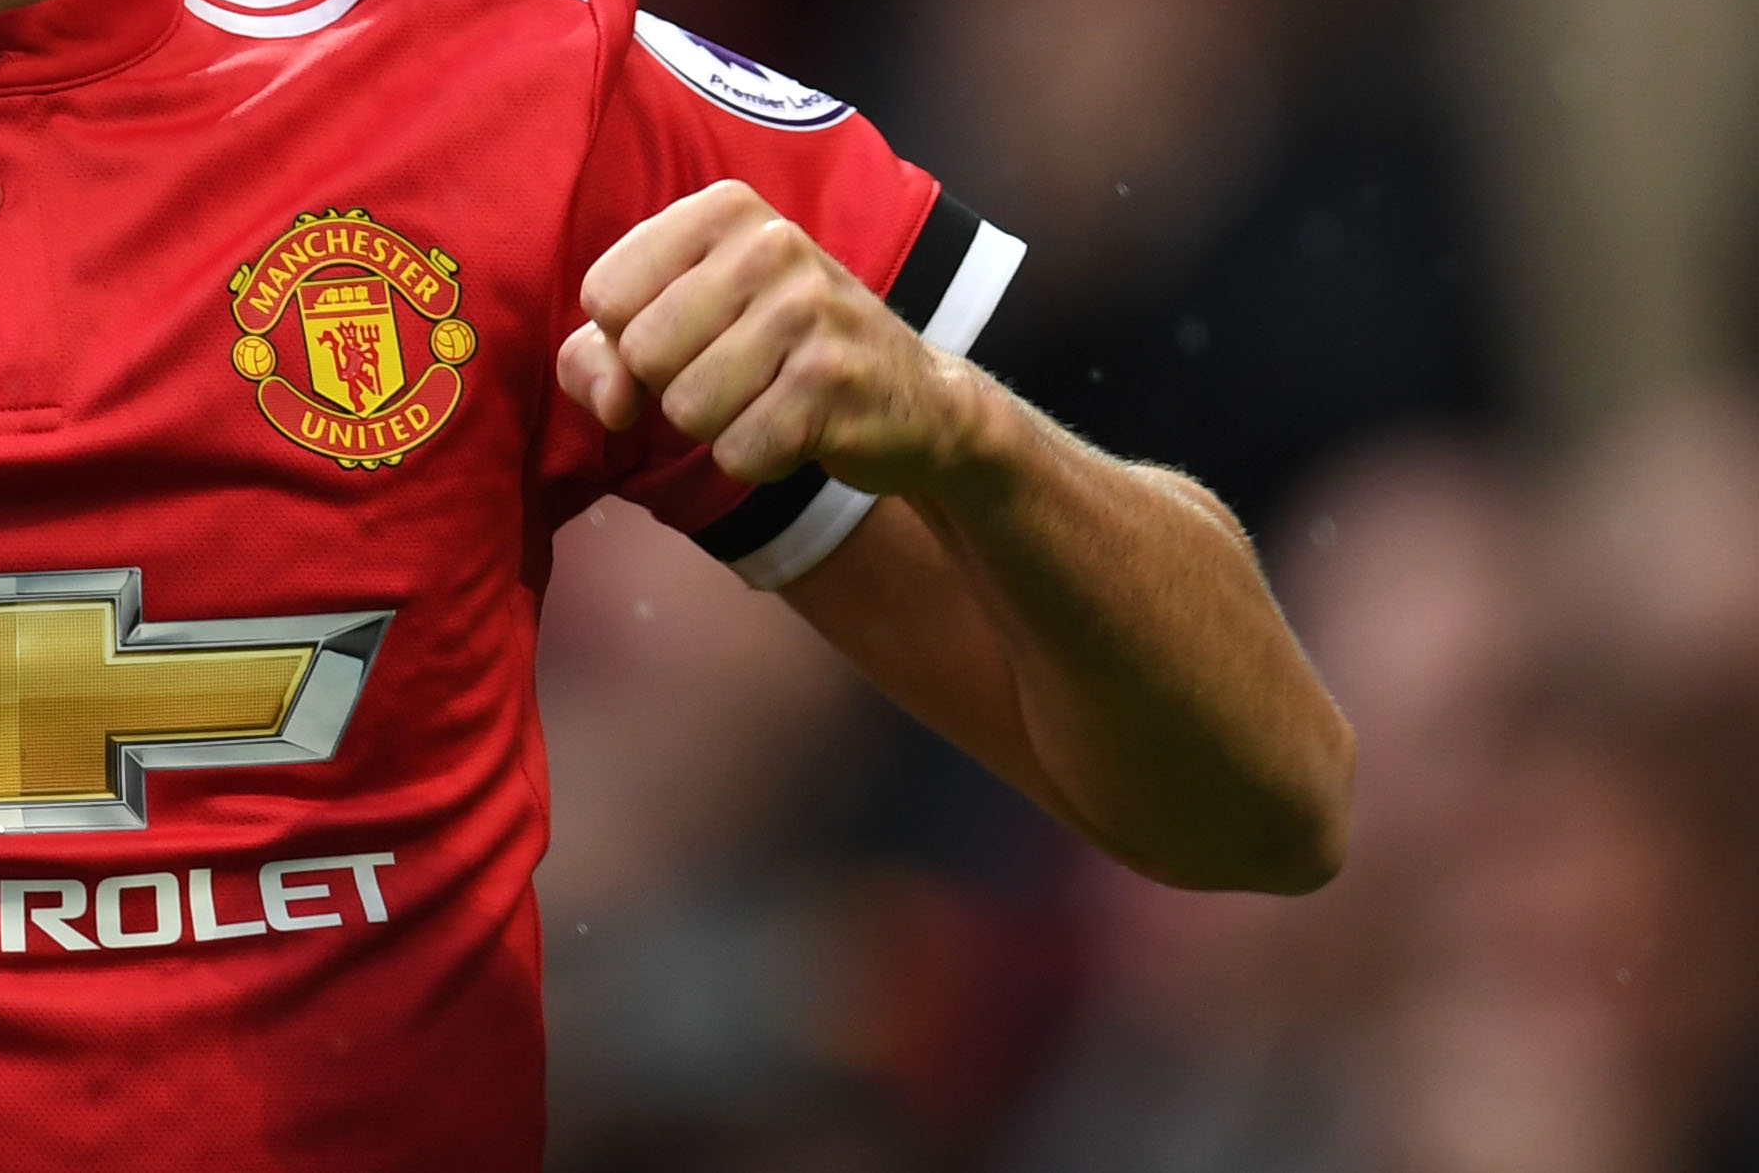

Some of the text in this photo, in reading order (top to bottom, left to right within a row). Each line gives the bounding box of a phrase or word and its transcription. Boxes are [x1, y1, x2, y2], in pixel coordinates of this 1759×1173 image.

[710, 73, 785, 109] Premier
[248, 228, 441, 314] MANCHESTER
[301, 403, 431, 450] UNITED
